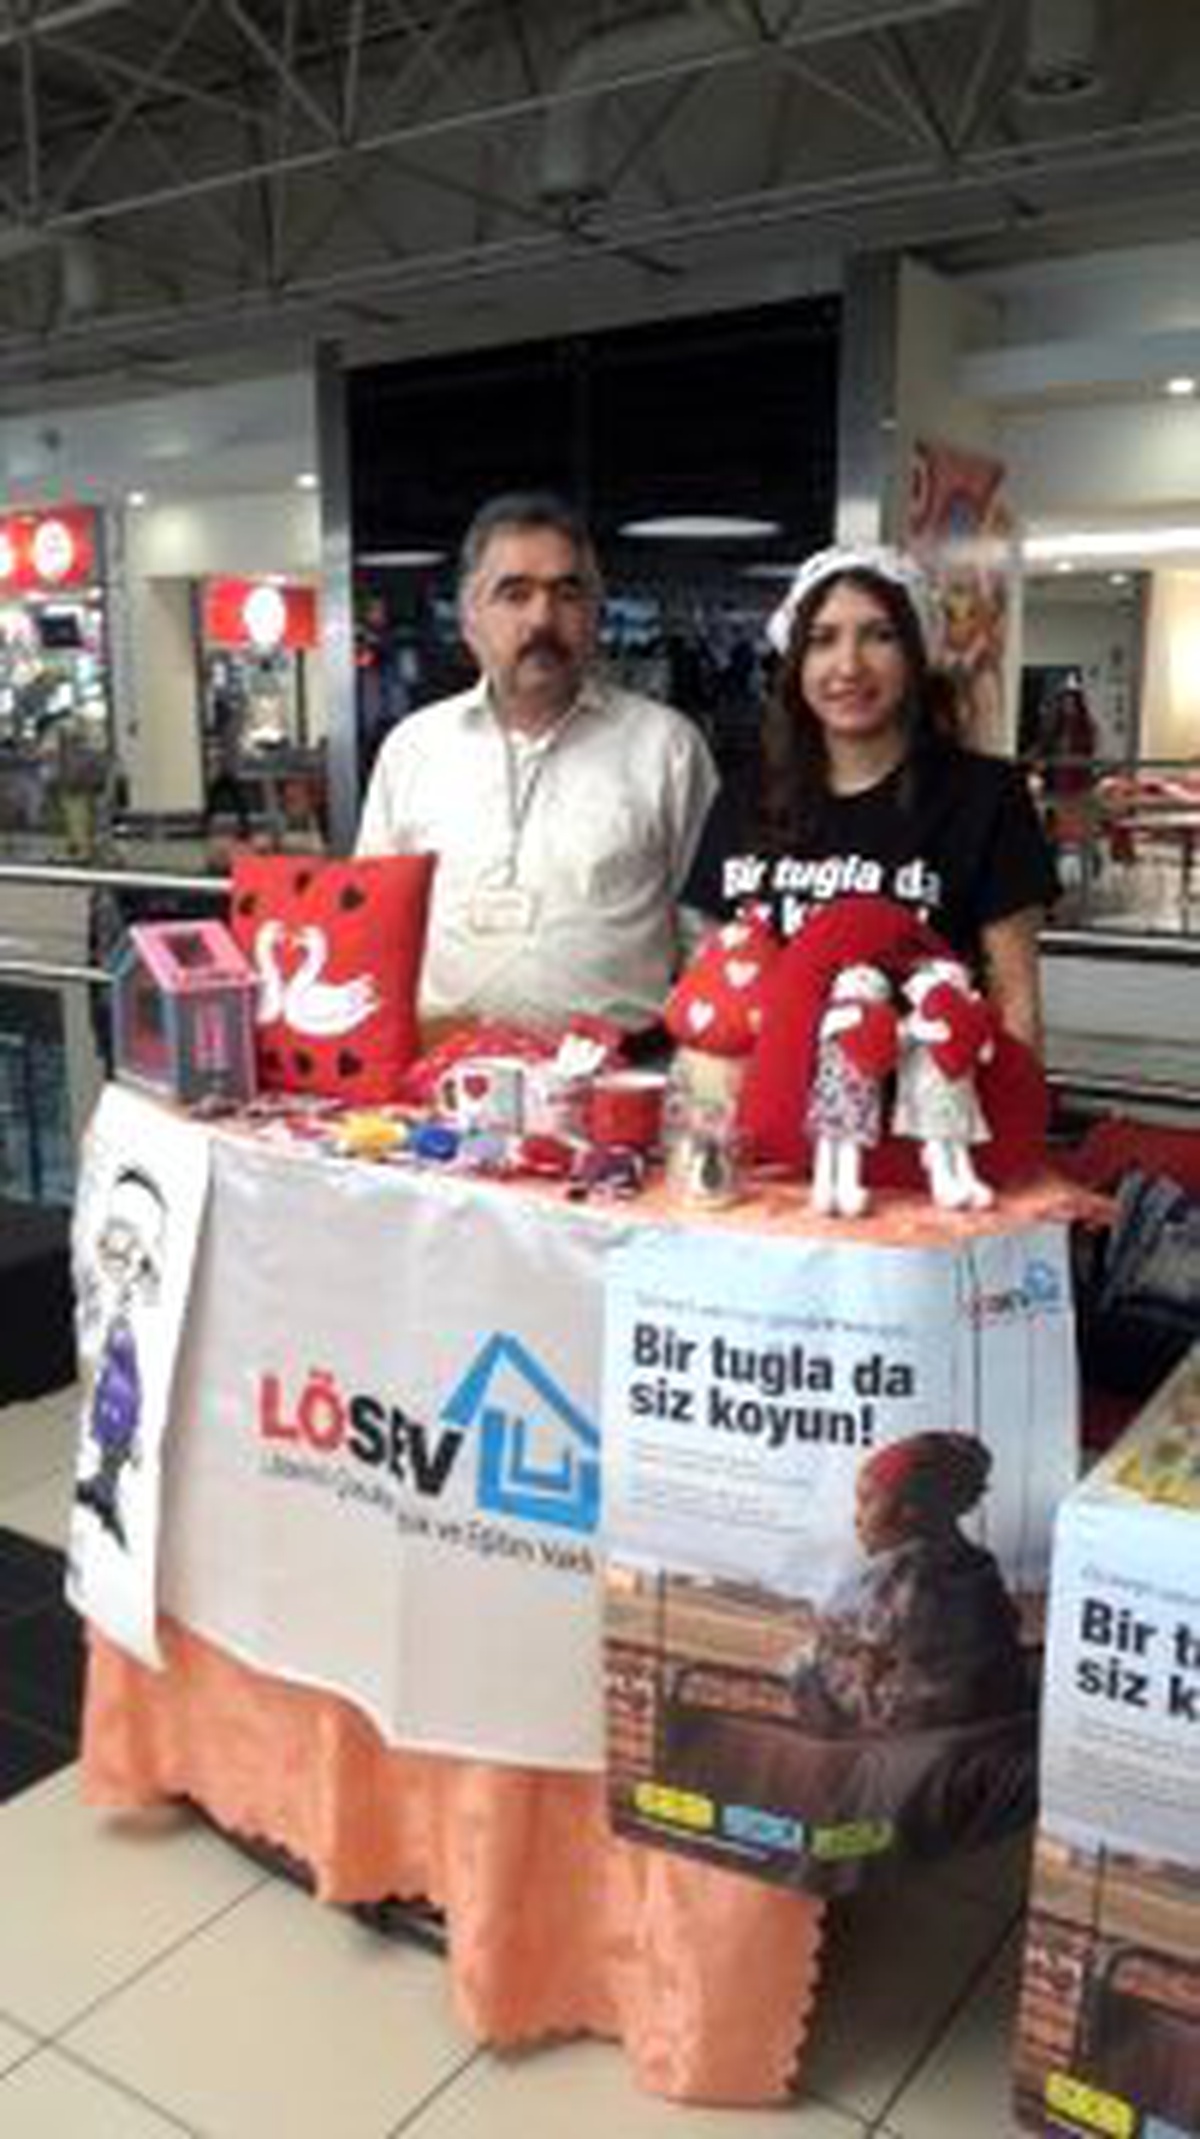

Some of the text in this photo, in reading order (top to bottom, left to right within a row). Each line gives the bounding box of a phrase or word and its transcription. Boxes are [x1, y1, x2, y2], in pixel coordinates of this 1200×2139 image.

[631, 1322, 698, 1374] Bir
[851, 1353, 916, 1399] da
[628, 1377, 876, 1449] siz koyun!
[1080, 1597, 1159, 1656] Bir
[1075, 1656, 1149, 1709] siz
